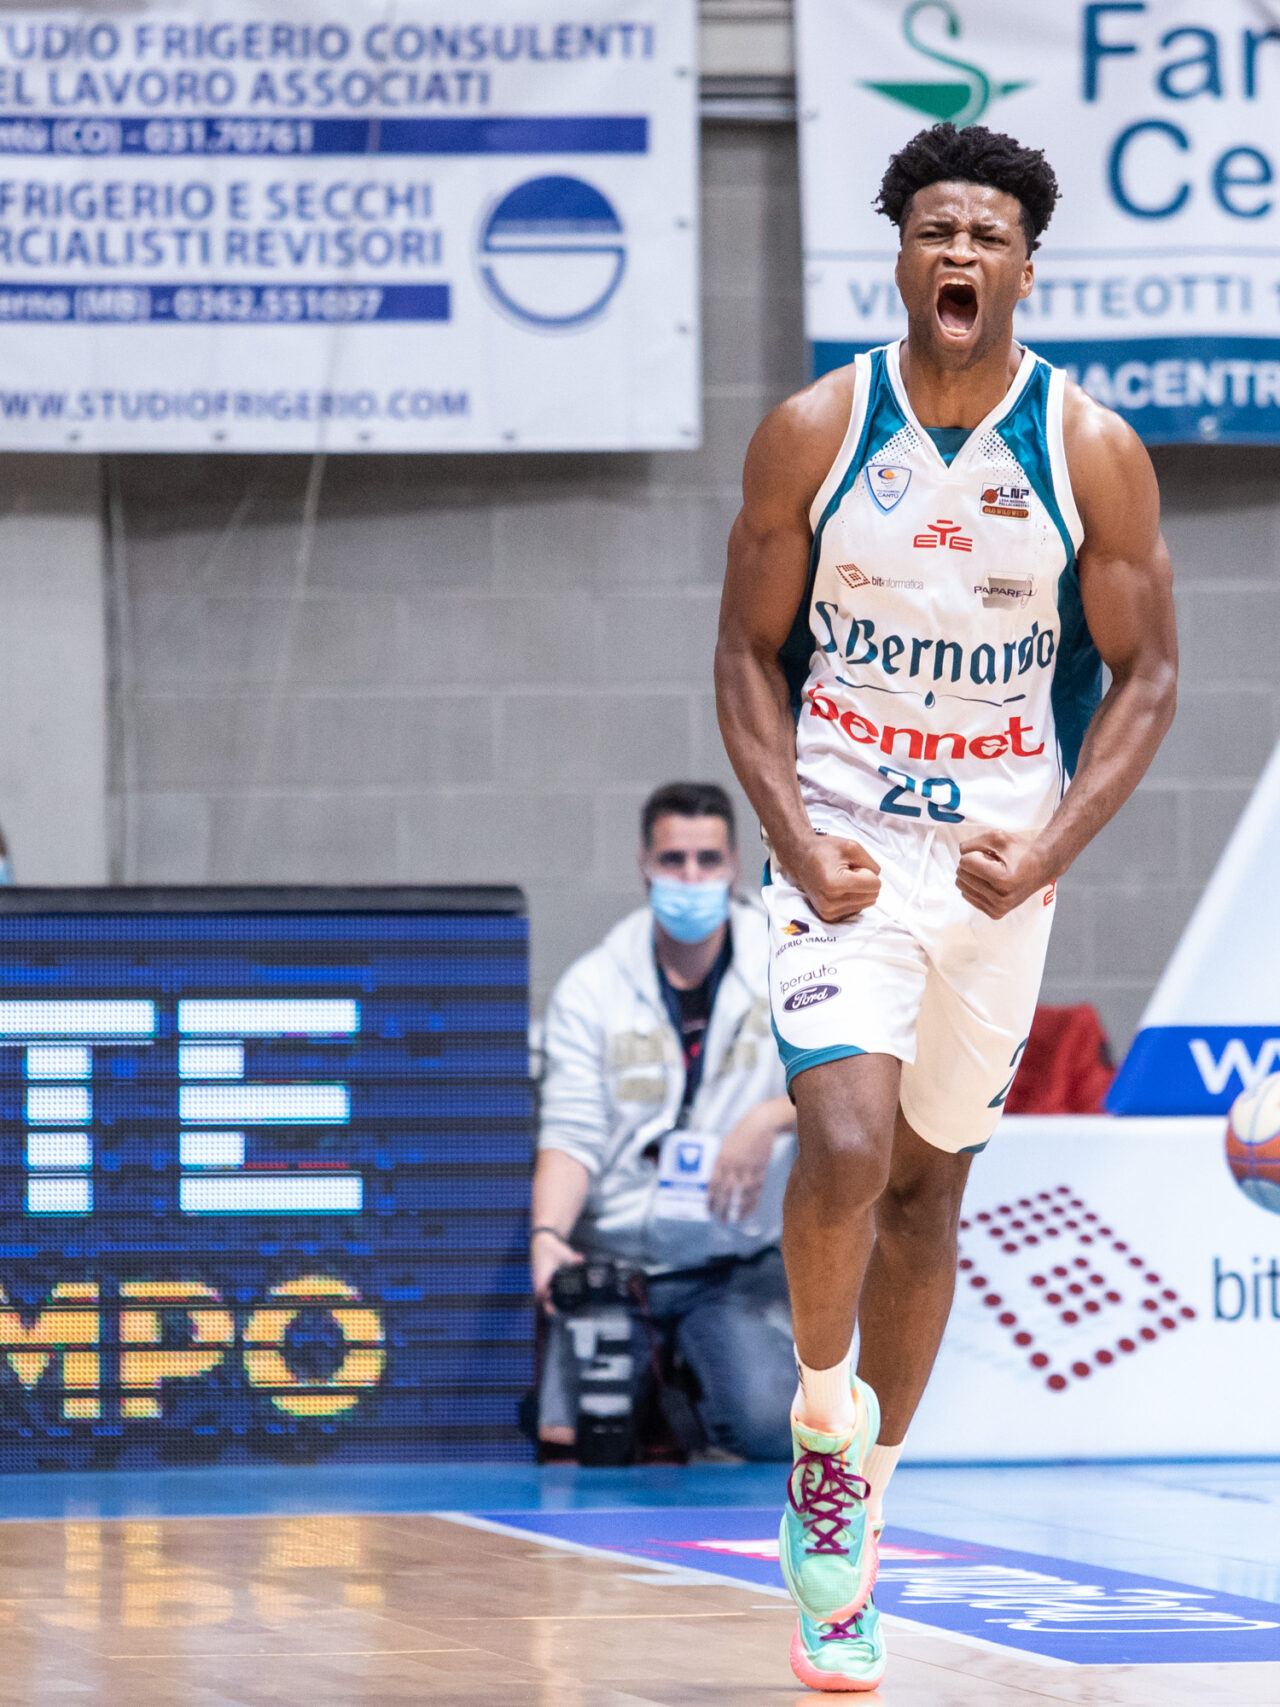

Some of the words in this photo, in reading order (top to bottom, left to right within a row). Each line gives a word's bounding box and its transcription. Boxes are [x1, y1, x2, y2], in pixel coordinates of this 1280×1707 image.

[136, 24, 350, 60] FRIGERIO
[364, 24, 653, 60] CONSULENTI
[49, 70, 235, 105] LAVORO
[251, 71, 490, 106] ASSOCIATI
[227, 183, 251, 219] E
[266, 182, 433, 220] SECCHI
[226, 229, 442, 266] REVISORI
[808, 683, 1045, 760] bennet
[780, 965, 837, 994] iperauto
